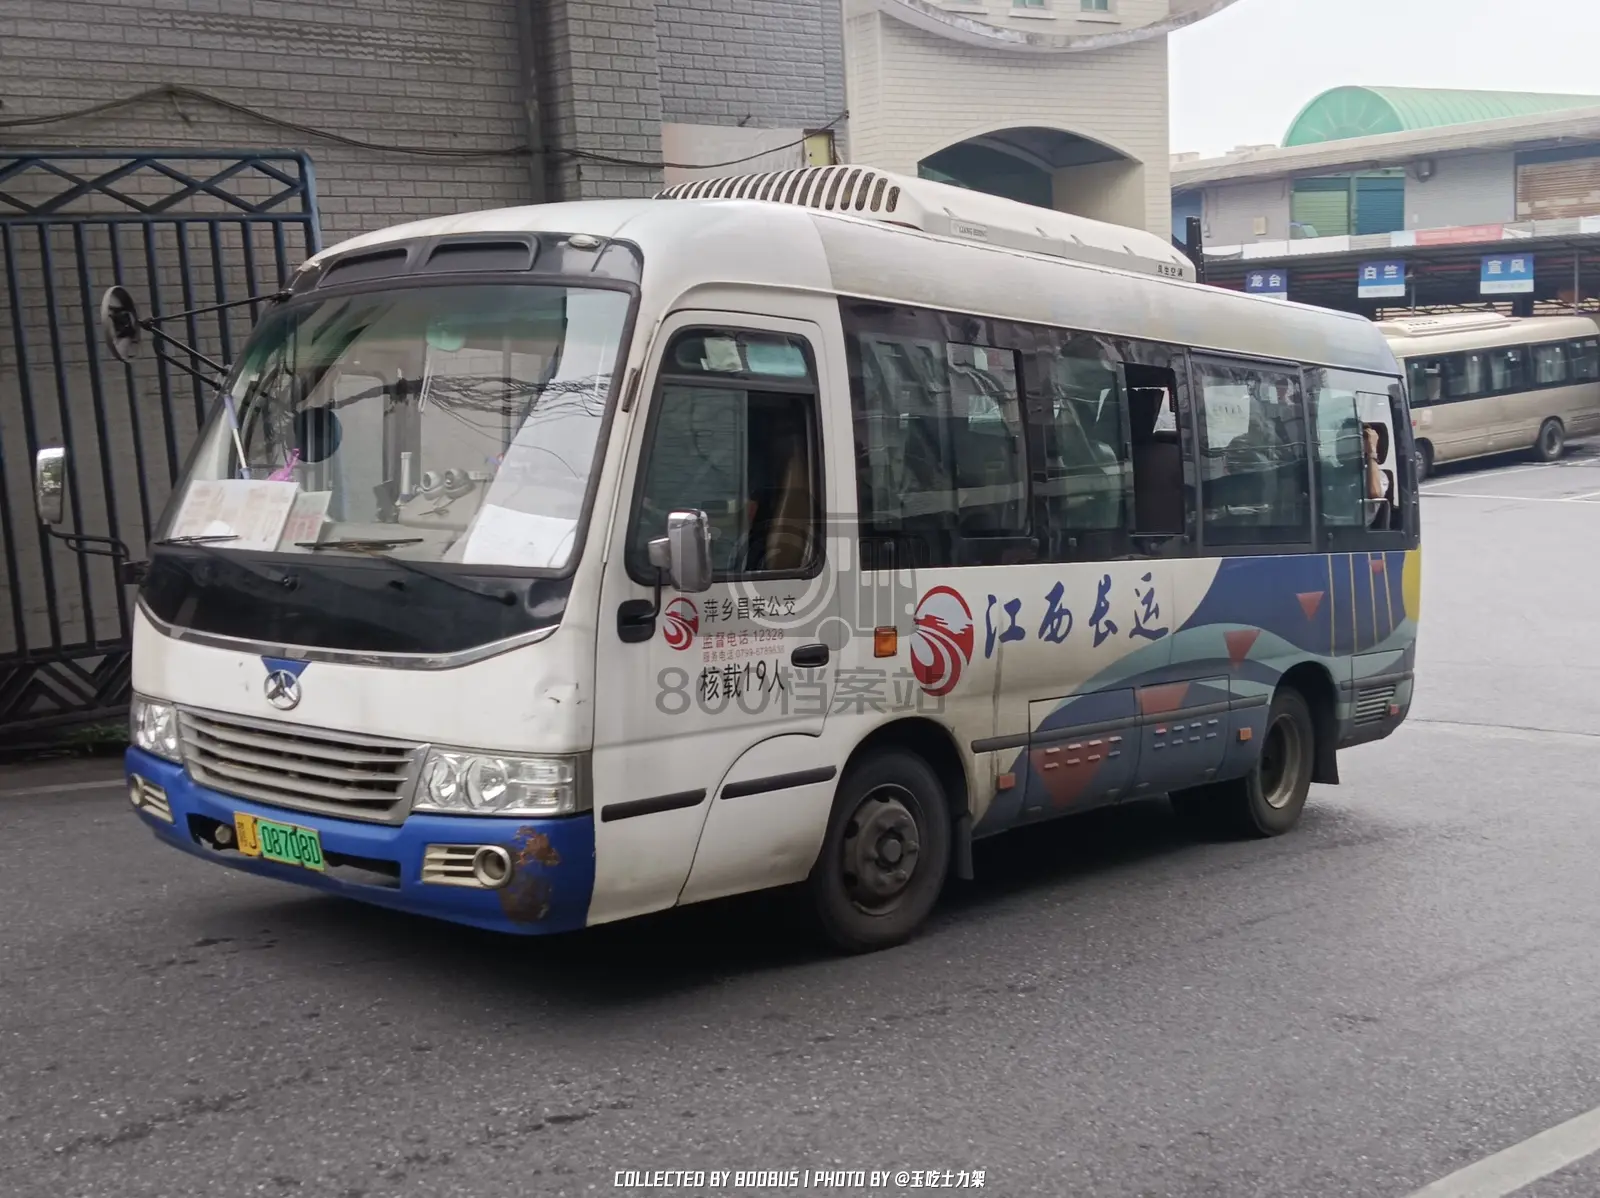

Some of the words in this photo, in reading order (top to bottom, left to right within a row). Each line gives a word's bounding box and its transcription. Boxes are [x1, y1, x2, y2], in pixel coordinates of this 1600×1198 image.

[1364, 265, 1398, 280] 白竺
[1487, 259, 1525, 274] 宣风
[703, 594, 796, 623] 萍乡昌荣公交
[984, 572, 1169, 659] 江西长运
[700, 659, 784, 702] 核载19人
